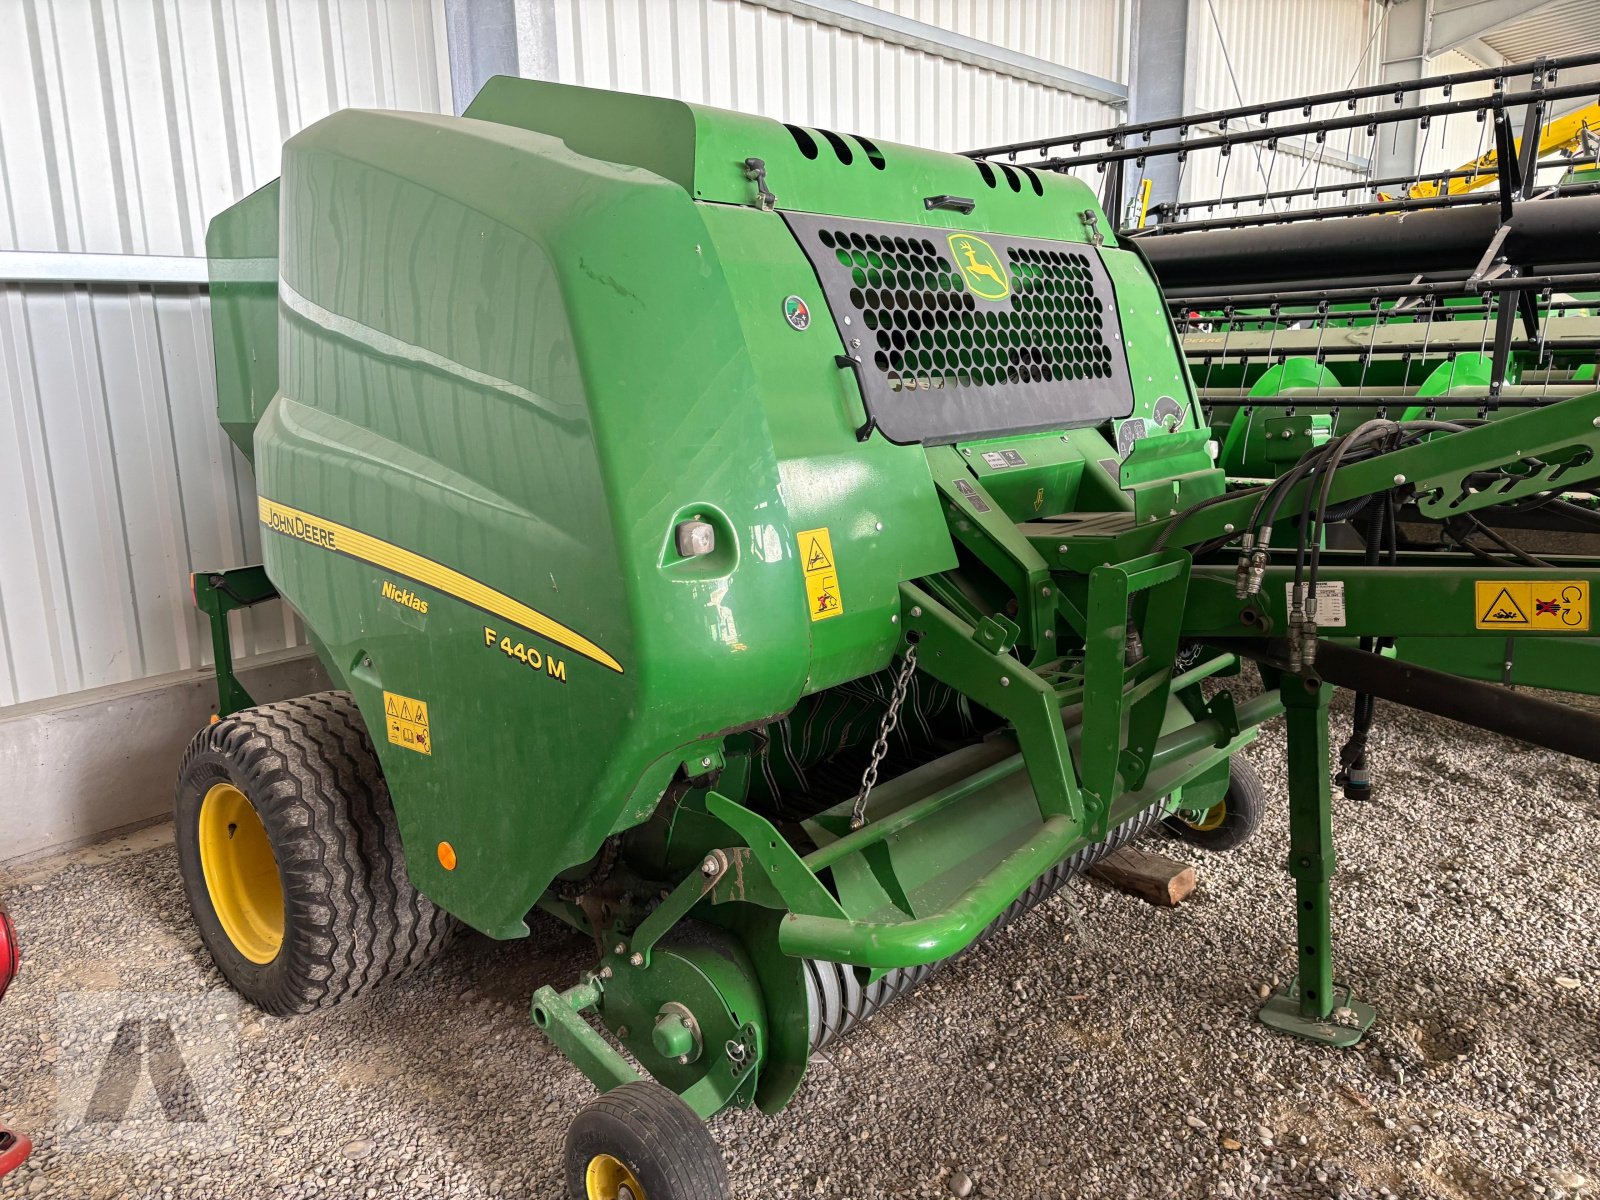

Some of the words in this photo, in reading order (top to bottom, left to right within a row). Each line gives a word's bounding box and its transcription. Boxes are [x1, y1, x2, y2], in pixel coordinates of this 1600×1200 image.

[381, 580, 428, 614] Nicklas
[484, 626, 496, 647] F
[500, 636, 542, 671] 440
[546, 654, 566, 684] M
